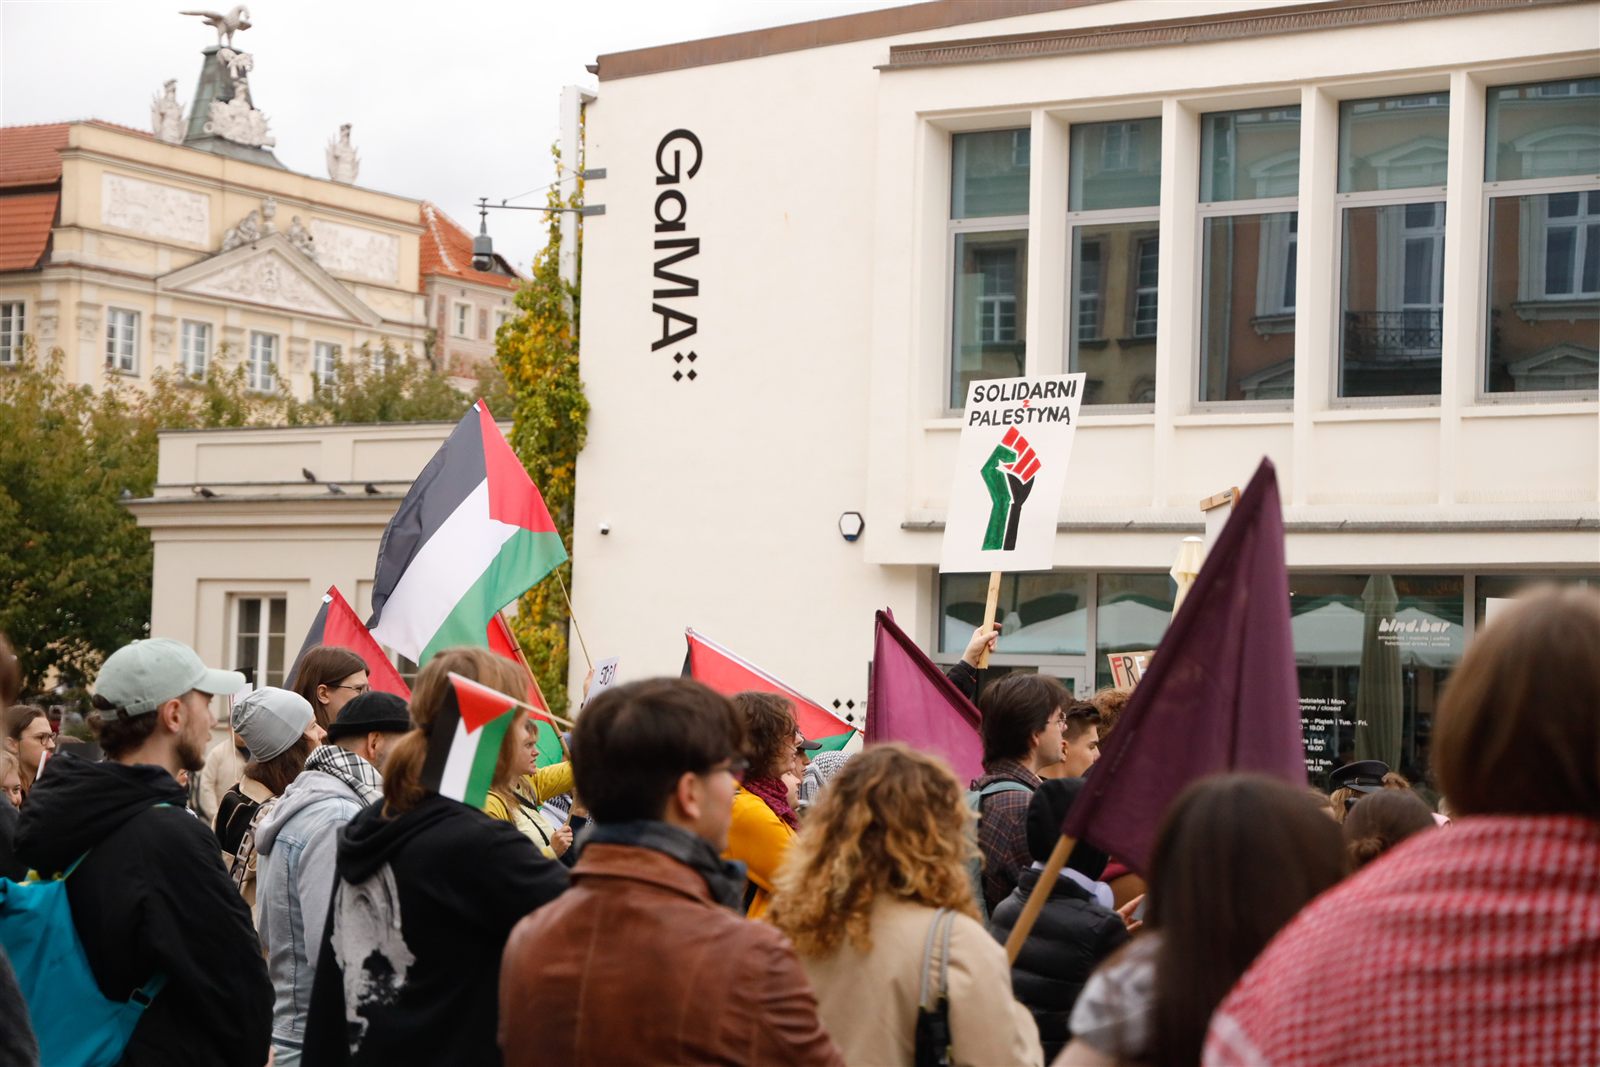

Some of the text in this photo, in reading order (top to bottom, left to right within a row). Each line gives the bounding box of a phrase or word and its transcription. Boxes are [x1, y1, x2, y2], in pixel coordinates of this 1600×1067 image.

[651, 128, 703, 353] GaMA
[972, 379, 1078, 403] SOLIDARNI
[968, 406, 1071, 426] PALESTYNĄ
